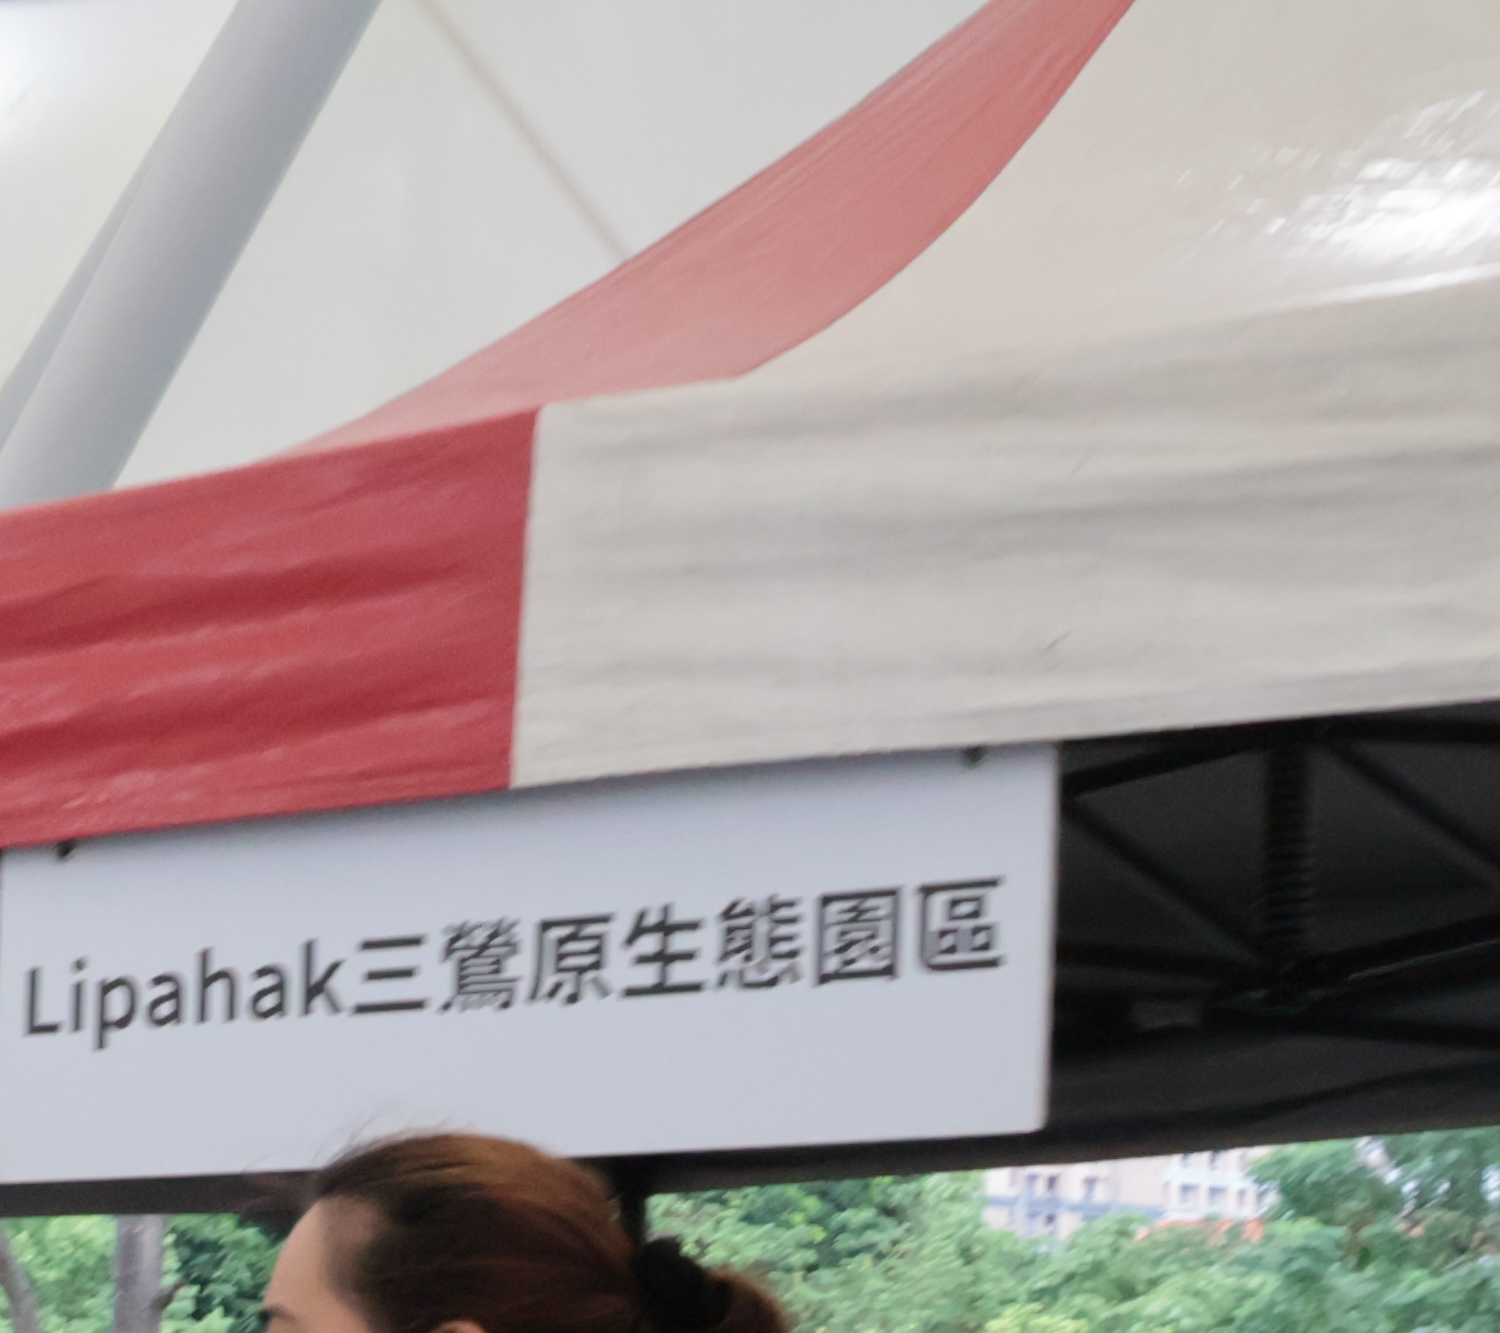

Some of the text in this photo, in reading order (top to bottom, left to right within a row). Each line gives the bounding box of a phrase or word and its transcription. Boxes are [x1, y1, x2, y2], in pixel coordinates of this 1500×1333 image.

[23, 877, 1004, 1050] Lipahak三鶯原生態園區
